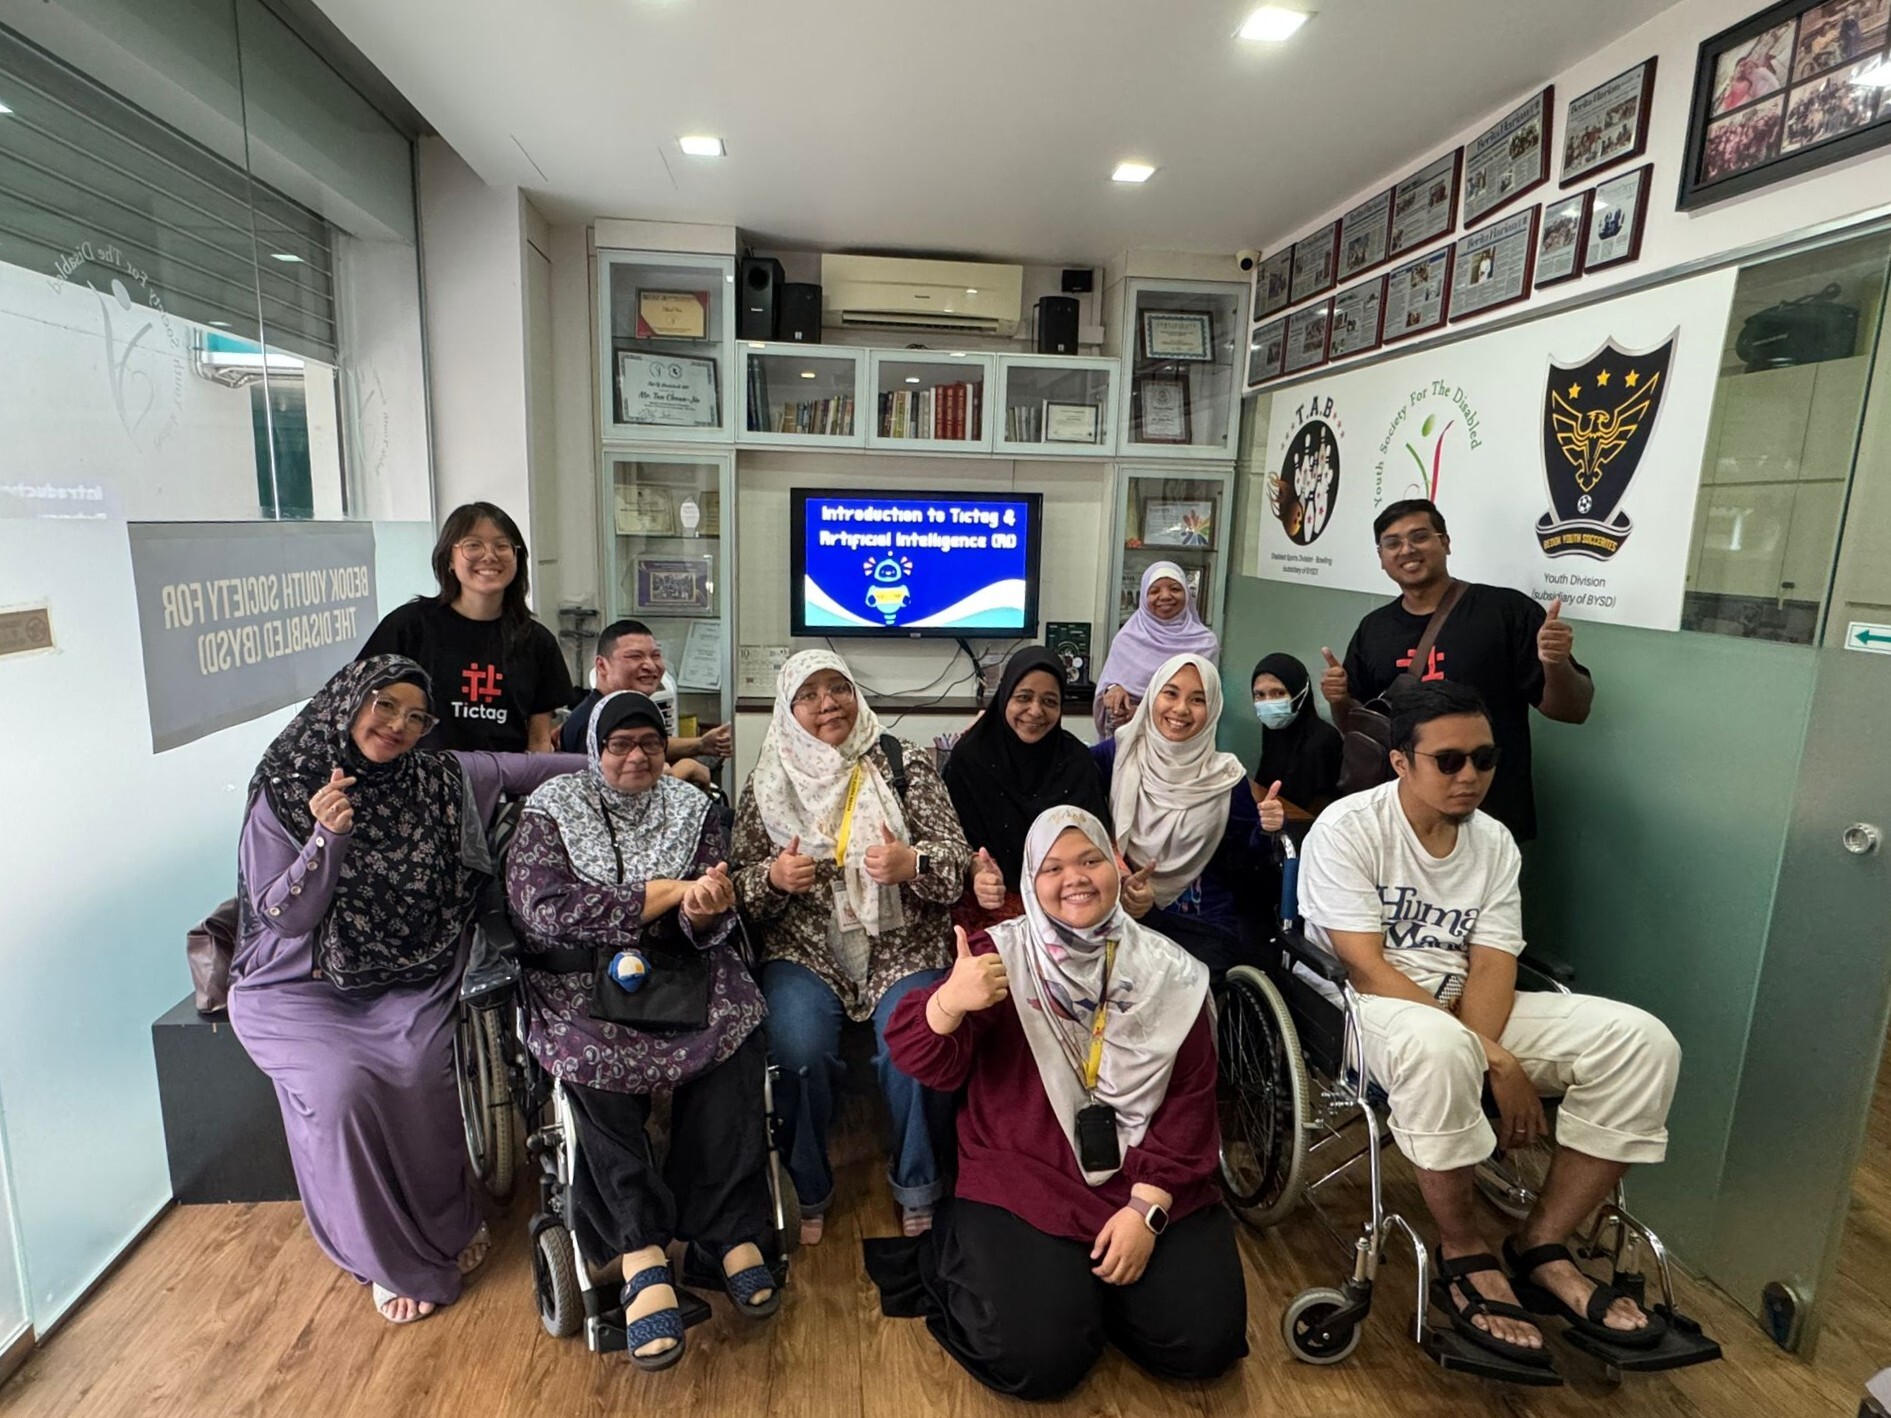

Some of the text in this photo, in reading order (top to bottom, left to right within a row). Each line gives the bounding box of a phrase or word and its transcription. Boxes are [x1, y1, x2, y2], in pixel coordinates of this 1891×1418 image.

[1296, 396, 1334, 424] T.A.B
[1374, 379, 1482, 508] Youth Society For The Disabled
[821, 505, 1016, 529] Introduction to Tictag &
[819, 530, 892, 550] Artificial
[896, 531, 987, 552] Intelligence
[1544, 573, 1606, 588] Youth Division
[1576, 593, 1587, 603] of
[1586, 594, 1617, 608] BYSD)
[451, 701, 508, 724] Tictag
